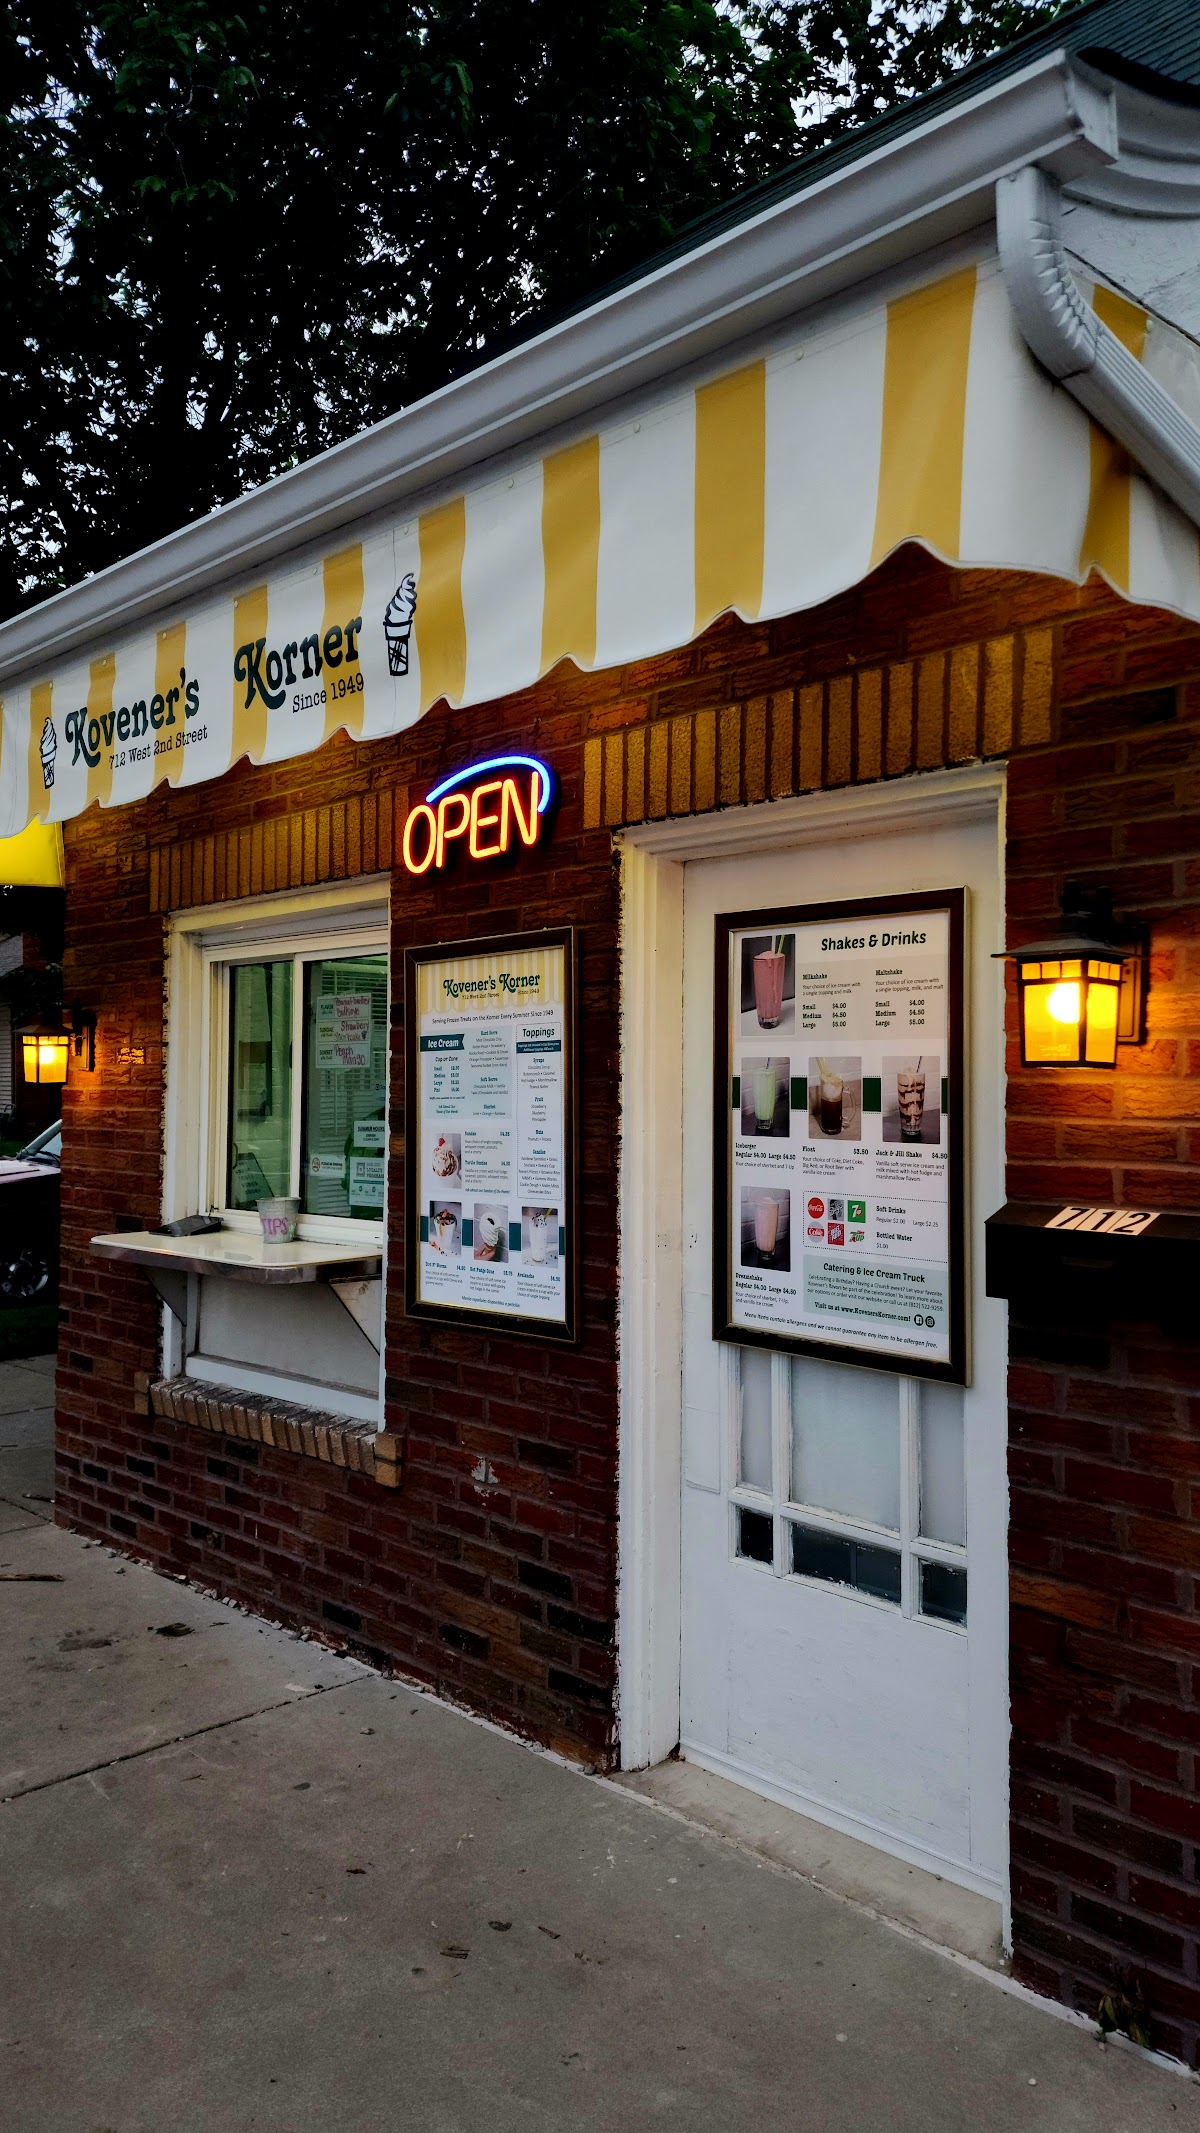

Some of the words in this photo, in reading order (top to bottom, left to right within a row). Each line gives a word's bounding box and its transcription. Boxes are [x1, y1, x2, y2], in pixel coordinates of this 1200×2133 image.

[65, 667, 200, 767] Kovener's
[234, 616, 362, 710] Korner
[292, 686, 327, 714] Since
[330, 672, 365, 701] 1949
[109, 752, 126, 770] 712
[129, 744, 151, 764] West
[154, 736, 173, 756] 2nd
[176, 725, 208, 752] Street
[402, 770, 539, 874] OPEN
[822, 937, 865, 951] Shakes
[869, 935, 878, 947] &
[882, 931, 926, 946] Drinks
[443, 975, 496, 998] Kovener's
[499, 974, 540, 993] Korner
[438, 1039, 459, 1047] Cream
[523, 1028, 555, 1038] Toppings
[261, 1218, 288, 1235] TIPS
[1055, 1207, 1151, 1233] 712
[897, 1234, 912, 1242] Water
[824, 1263, 855, 1275] Catering
[864, 1268, 874, 1276] Ice
[877, 1270, 901, 1280] Cream
[903, 1273, 925, 1283] Truck
[769, 1286, 781, 1294] Large
[904, 1338, 924, 1346] allergen
